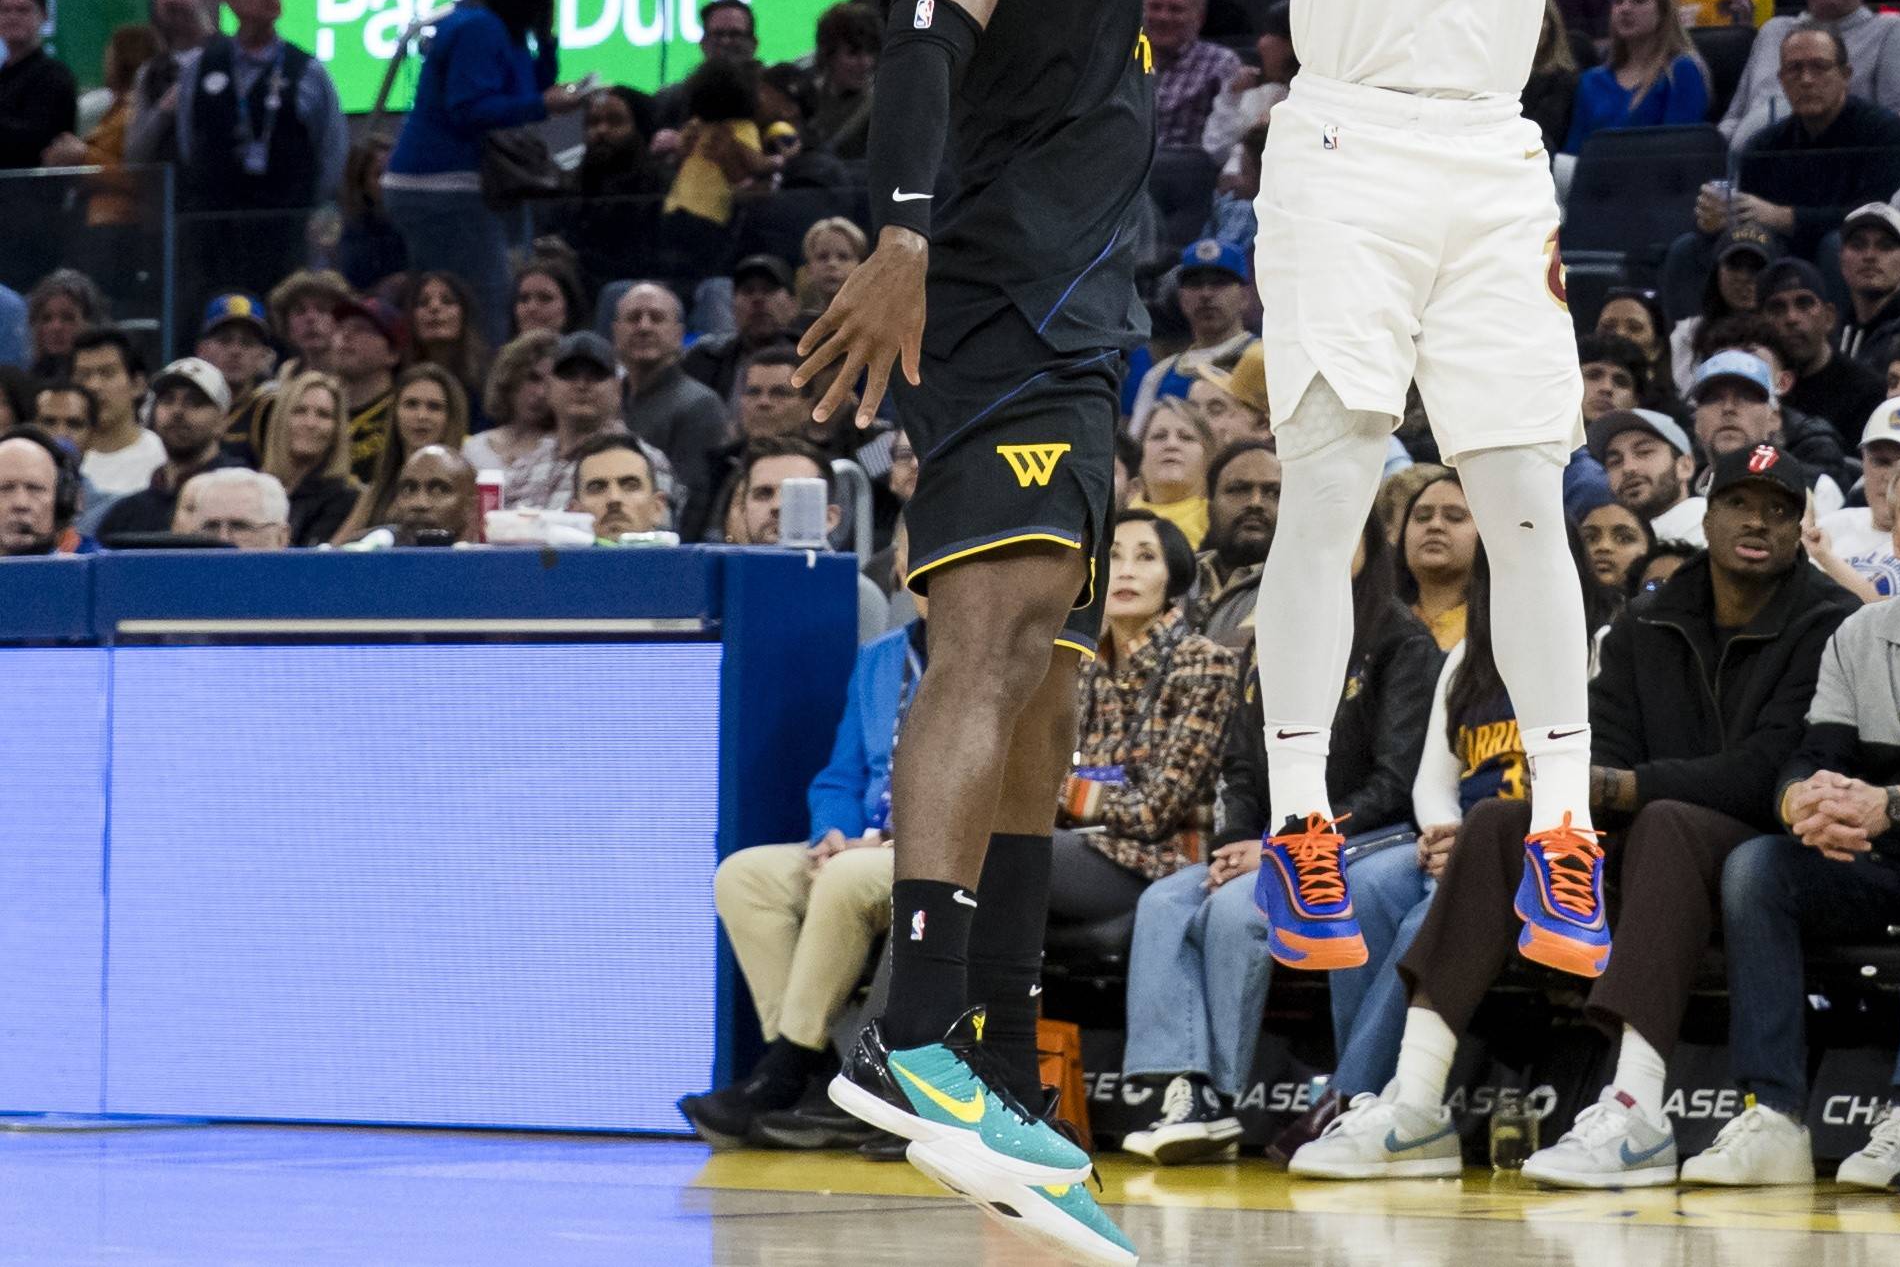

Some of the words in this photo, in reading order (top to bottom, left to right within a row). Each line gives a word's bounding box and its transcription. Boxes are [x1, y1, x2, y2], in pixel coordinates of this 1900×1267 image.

[996, 442, 1072, 488] W
[1232, 1082, 1311, 1112] ASE
[1448, 1086, 1520, 1115] ASE
[1662, 1088, 1738, 1119] ASE
